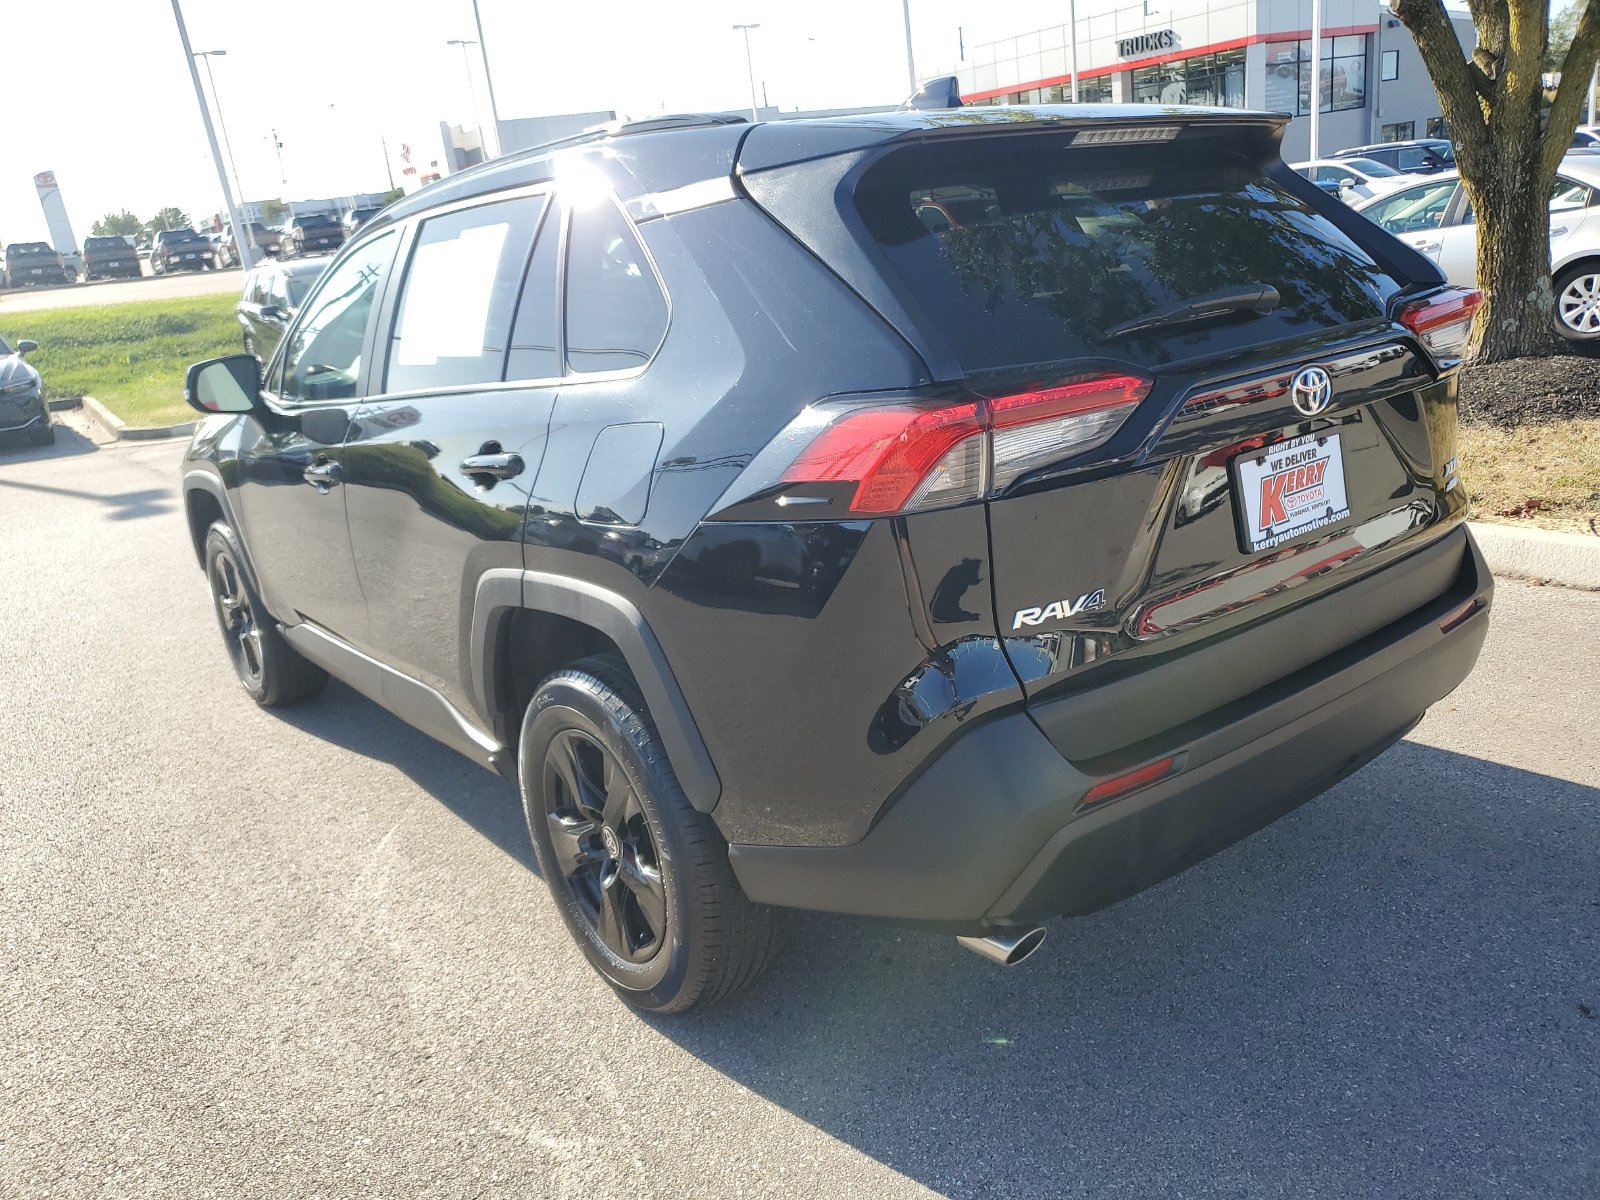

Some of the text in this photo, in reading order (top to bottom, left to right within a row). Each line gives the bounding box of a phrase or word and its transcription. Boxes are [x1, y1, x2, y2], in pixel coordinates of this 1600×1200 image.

[1115, 29, 1174, 57] TRUCKS
[1268, 433, 1316, 455] RIGHT BY YOU
[1270, 448, 1317, 472] WE DELIVER
[1260, 457, 1329, 531] KERRY
[1297, 489, 1322, 504] TOYOTA
[1253, 509, 1350, 552] kerryautomotive.com
[1012, 588, 1106, 630] RAV4
